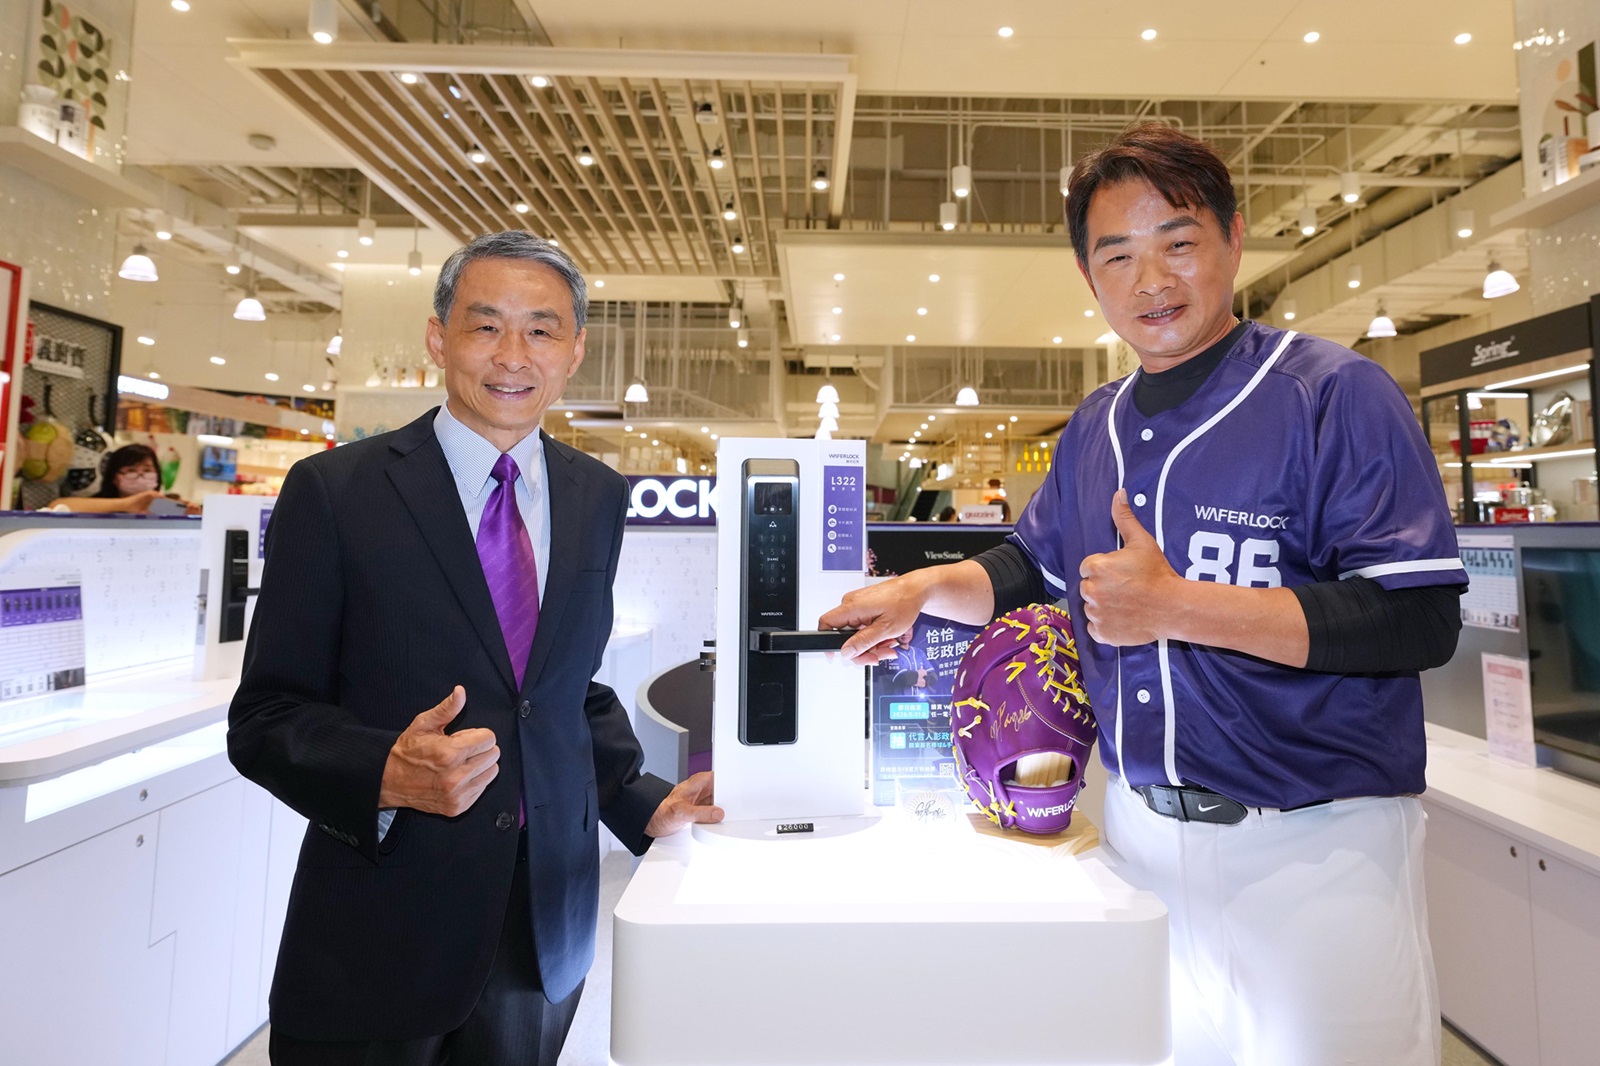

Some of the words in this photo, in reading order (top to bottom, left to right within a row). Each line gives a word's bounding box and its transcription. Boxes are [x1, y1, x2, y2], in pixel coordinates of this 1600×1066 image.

[831, 476, 856, 486] L322
[1194, 504, 1290, 530] WAFERLOCK
[924, 551, 965, 560] ViewSonic
[1185, 530, 1282, 589] 86
[925, 626, 955, 645] 恰恰
[925, 640, 973, 660] 彭政閔
